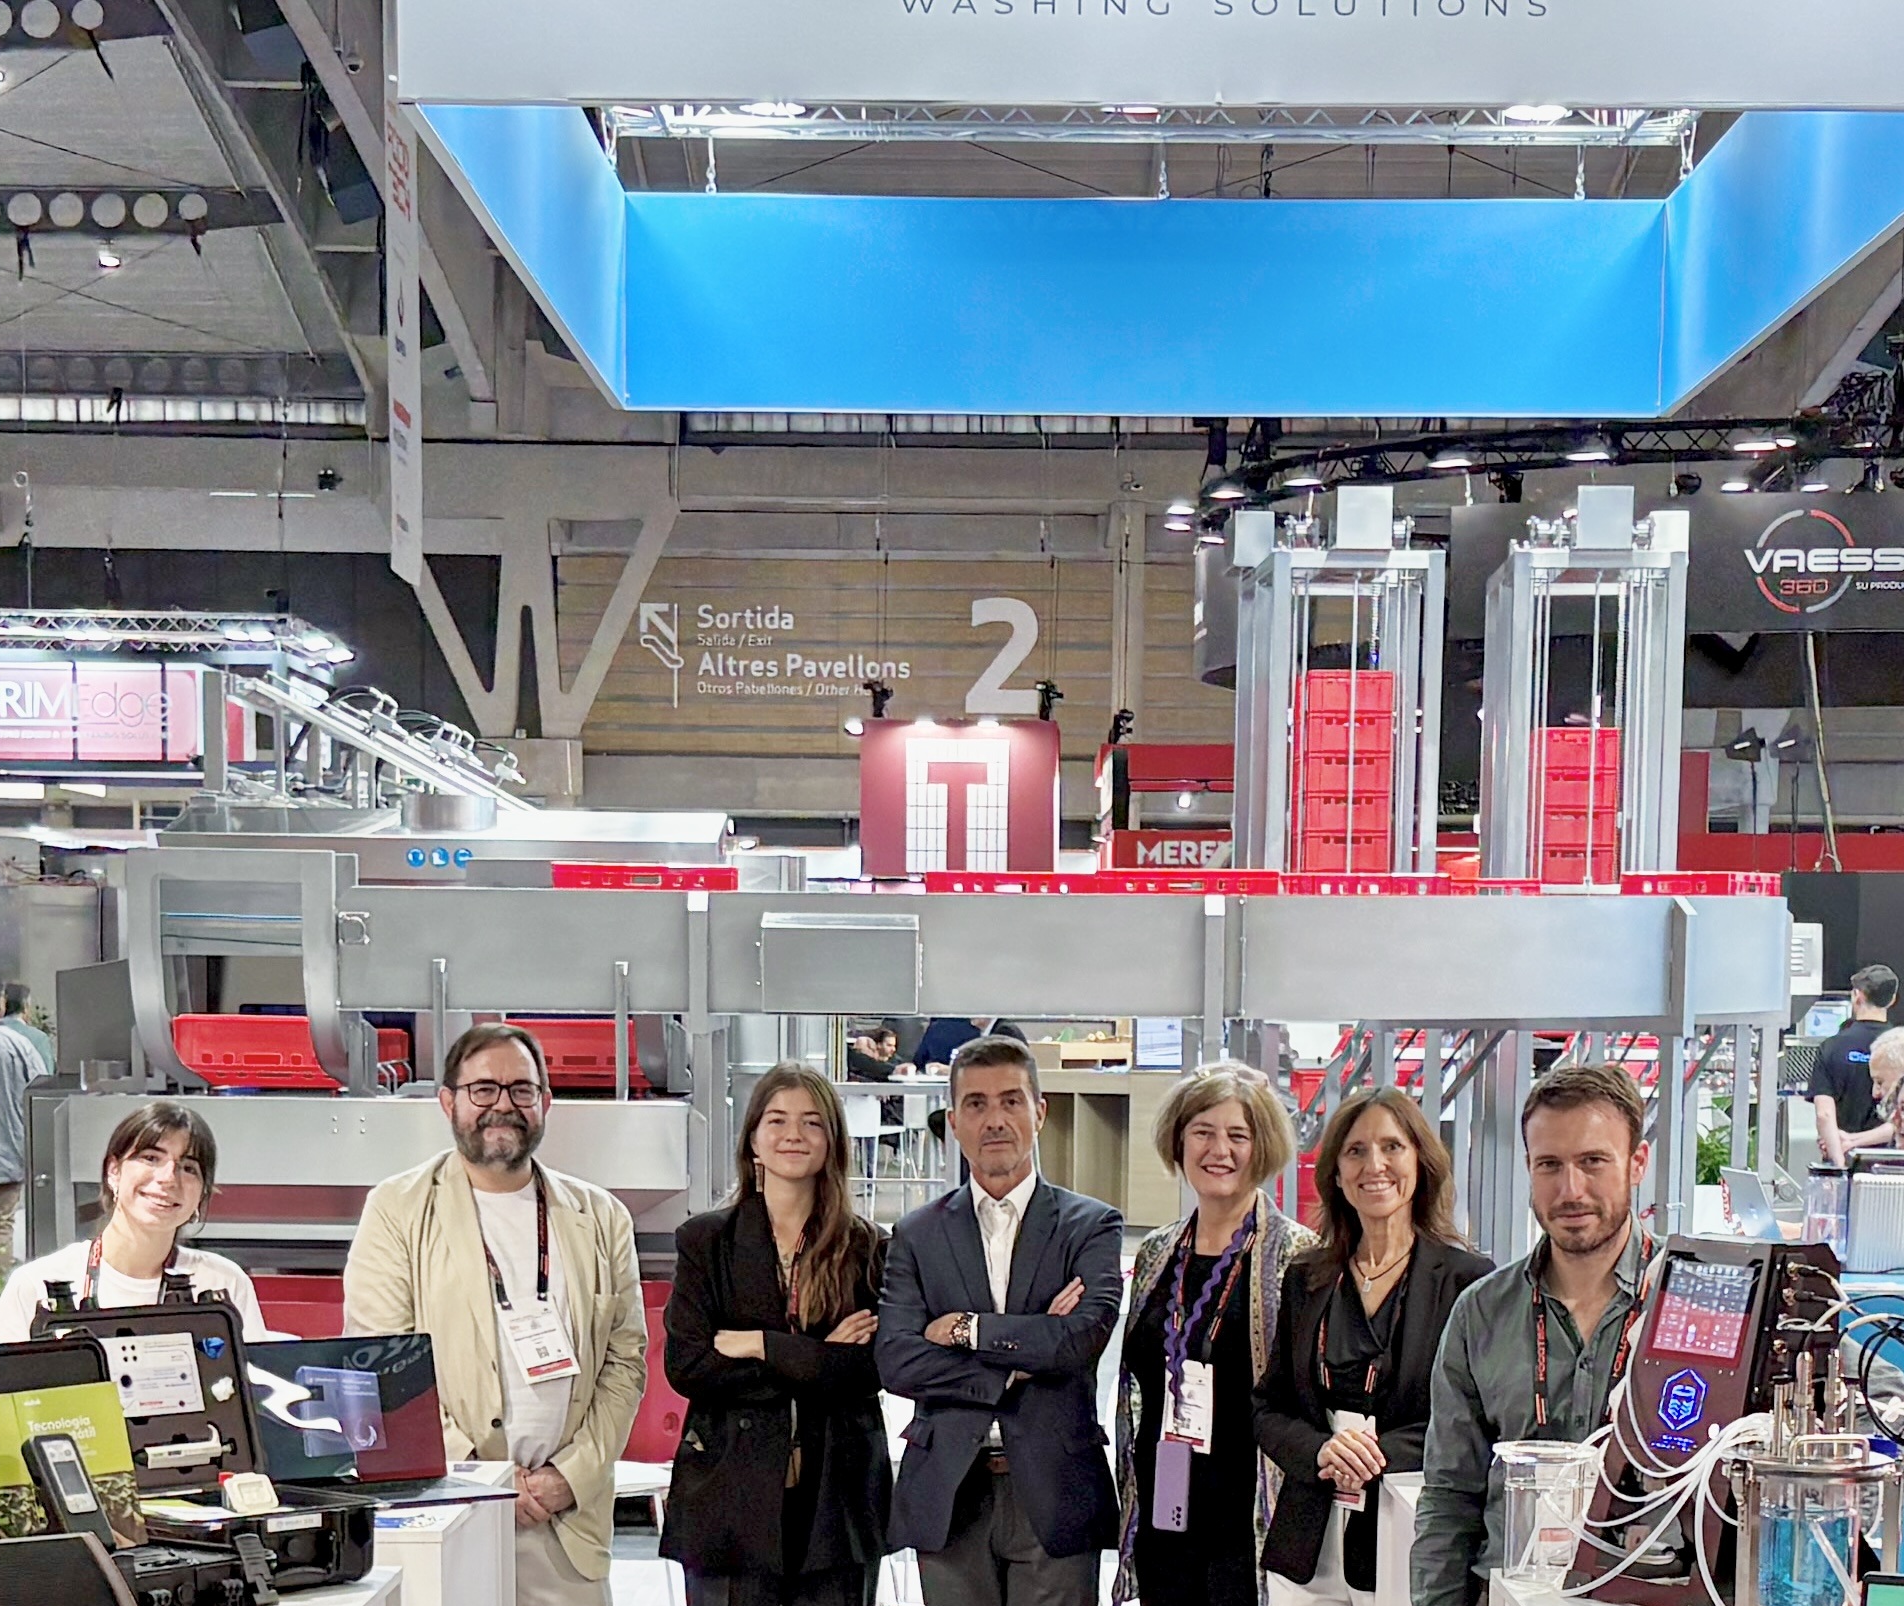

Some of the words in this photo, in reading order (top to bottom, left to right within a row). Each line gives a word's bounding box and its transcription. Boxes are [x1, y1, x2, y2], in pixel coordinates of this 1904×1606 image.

[697, 604, 794, 630] Sortida
[748, 634, 773, 647] Exit
[698, 651, 779, 678] Altres
[786, 653, 911, 679] Pavellons
[965, 597, 1041, 714] 2
